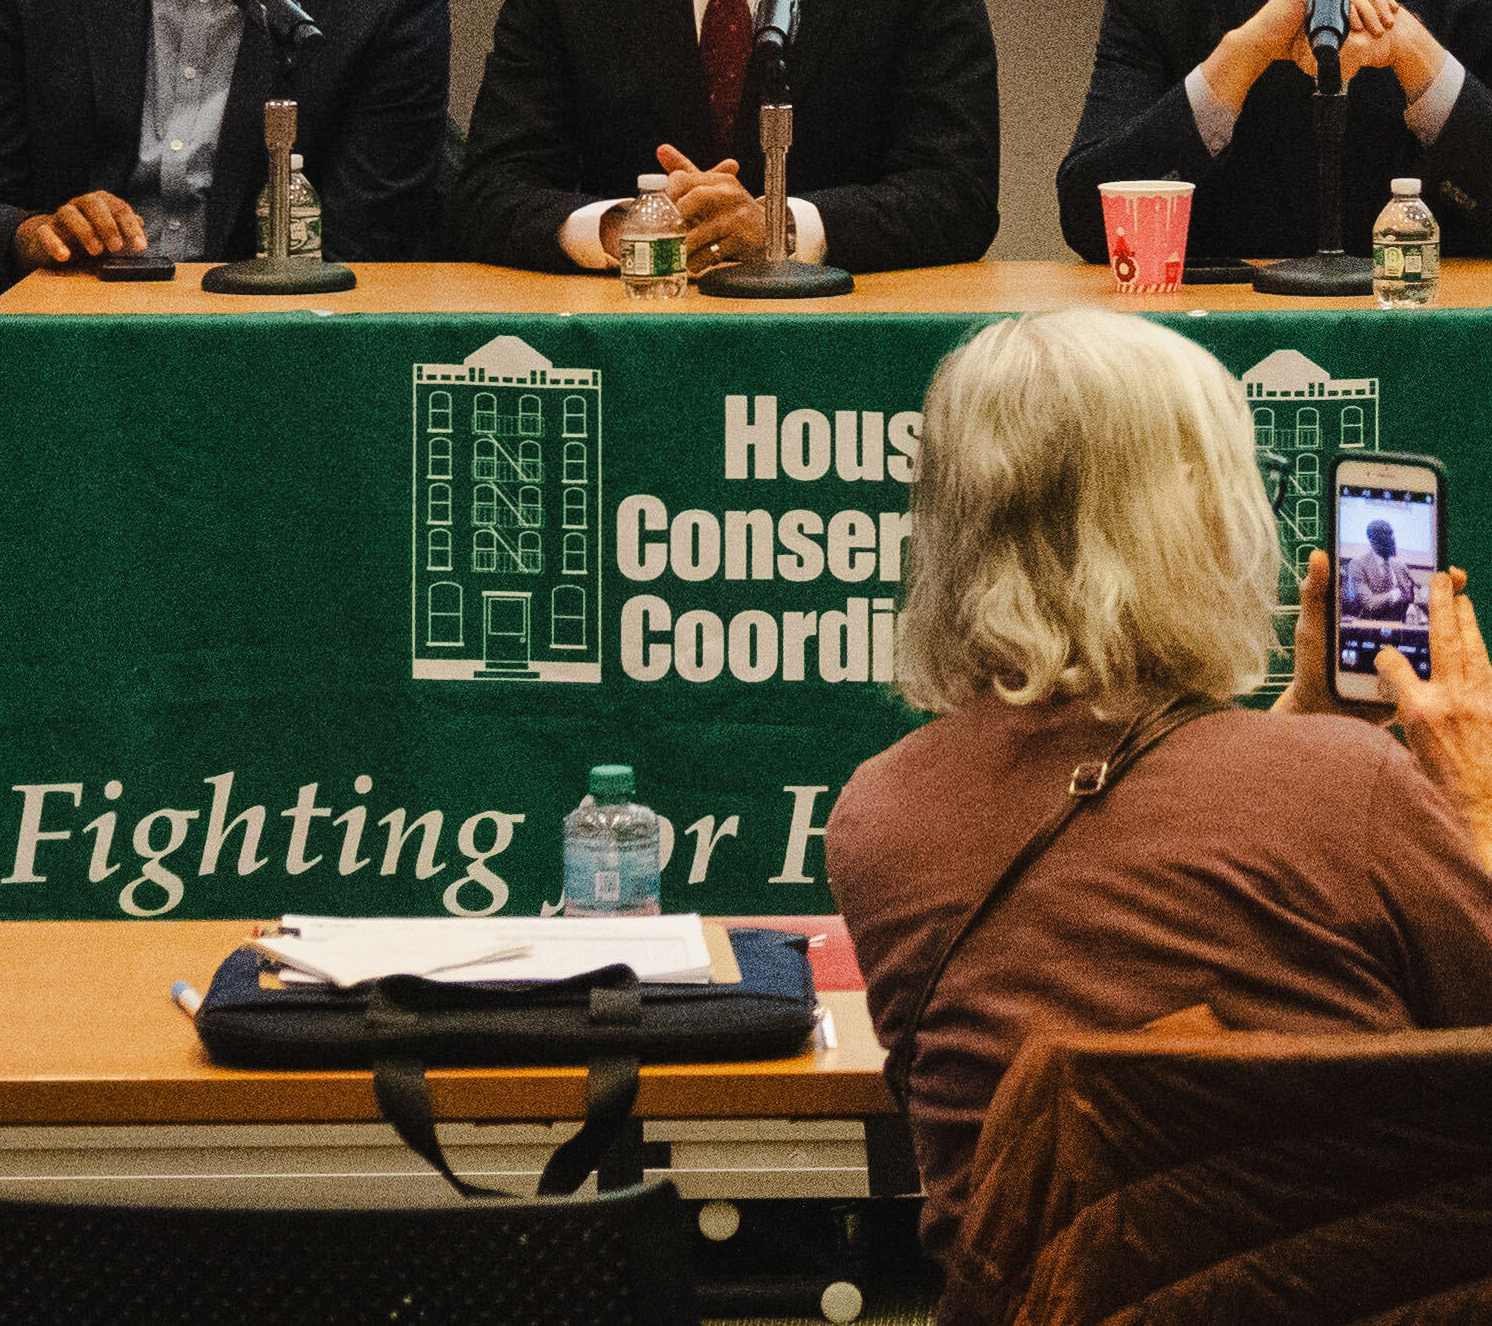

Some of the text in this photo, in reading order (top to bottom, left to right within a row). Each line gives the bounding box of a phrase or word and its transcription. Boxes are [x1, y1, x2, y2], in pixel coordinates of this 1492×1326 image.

[724, 394, 925, 484] Hous
[616, 493, 913, 583] Conser
[620, 593, 896, 684] Coordi
[0, 771, 526, 918] Fighting
